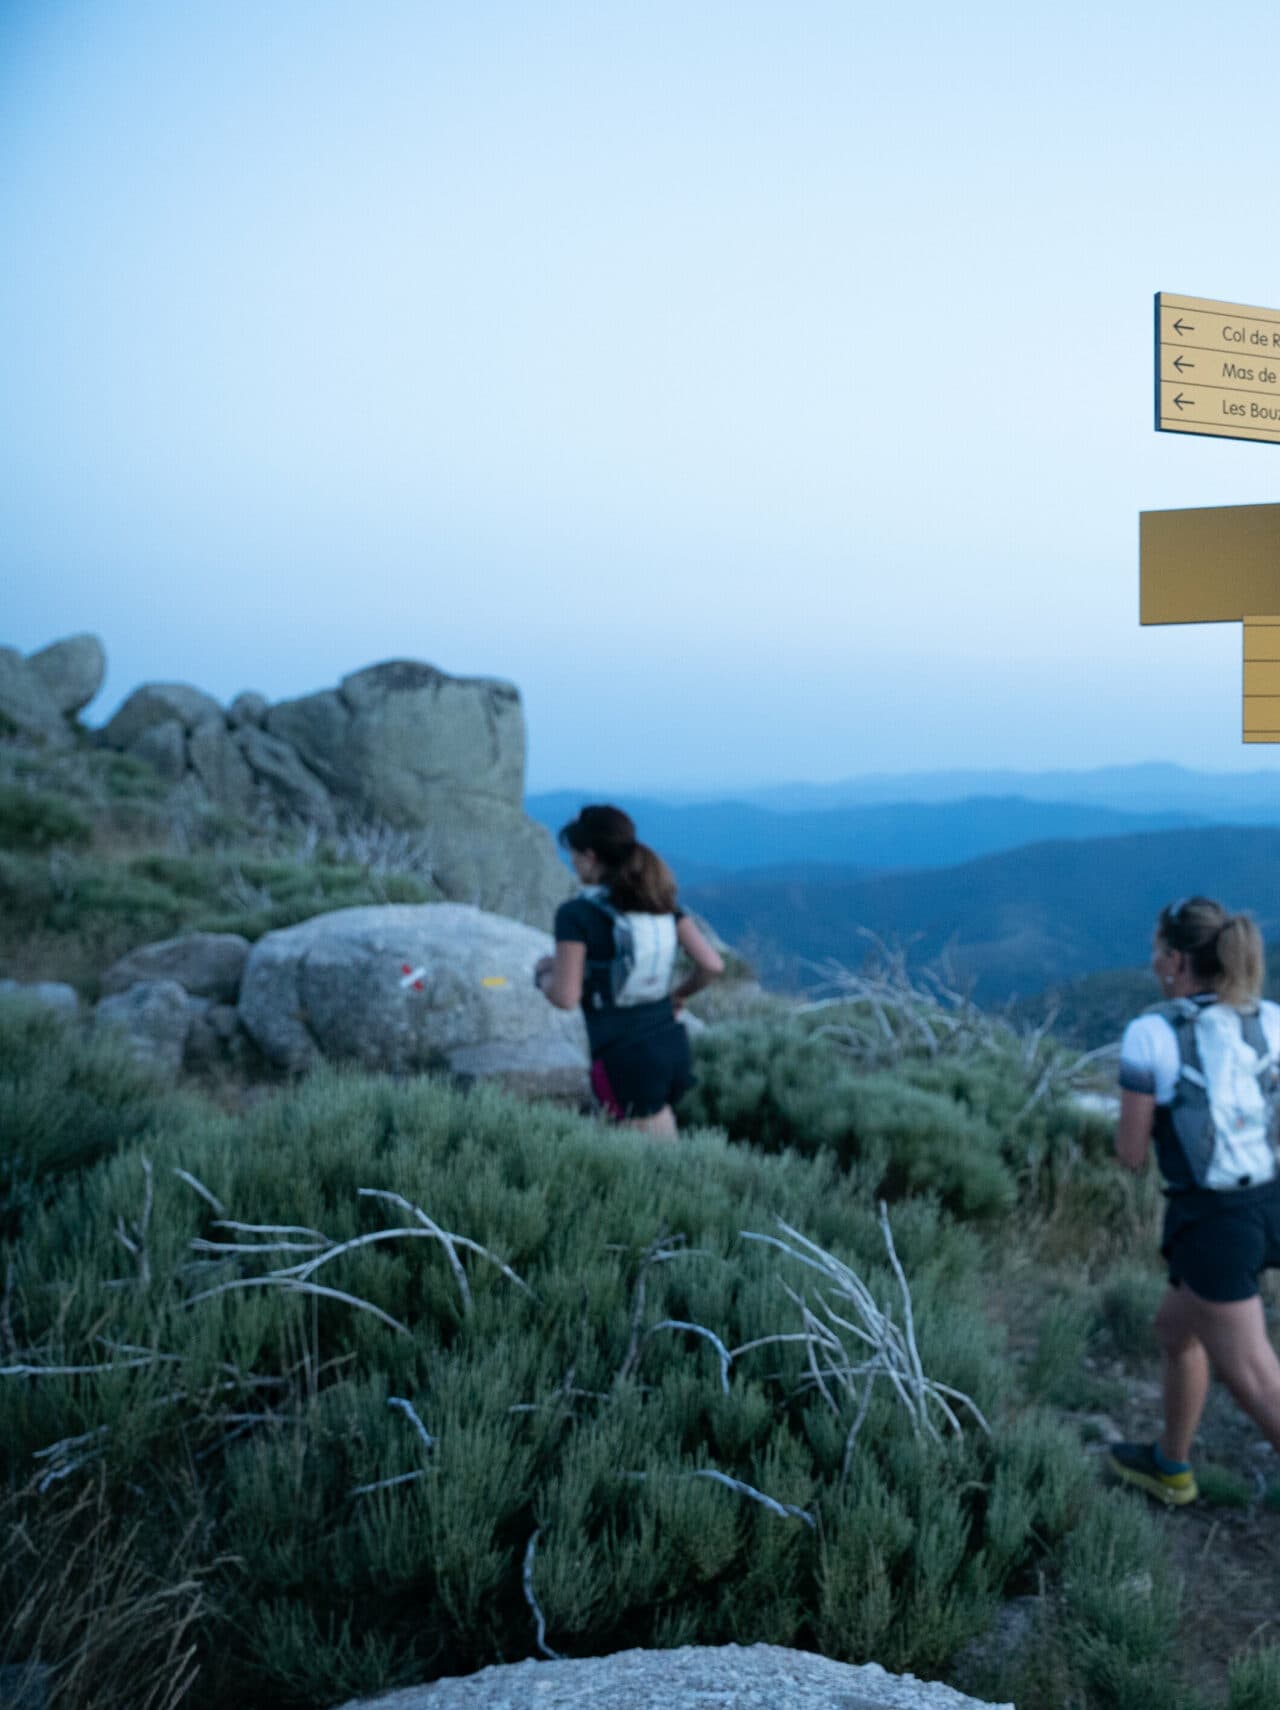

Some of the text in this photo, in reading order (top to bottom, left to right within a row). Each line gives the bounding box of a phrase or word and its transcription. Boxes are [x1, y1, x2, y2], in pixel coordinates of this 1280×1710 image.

[1222, 326, 1246, 344] Col
[1250, 330, 1268, 346] de
[1222, 363, 1254, 381] Mas
[1258, 368, 1277, 384] de
[1222, 399, 1246, 416] Les
